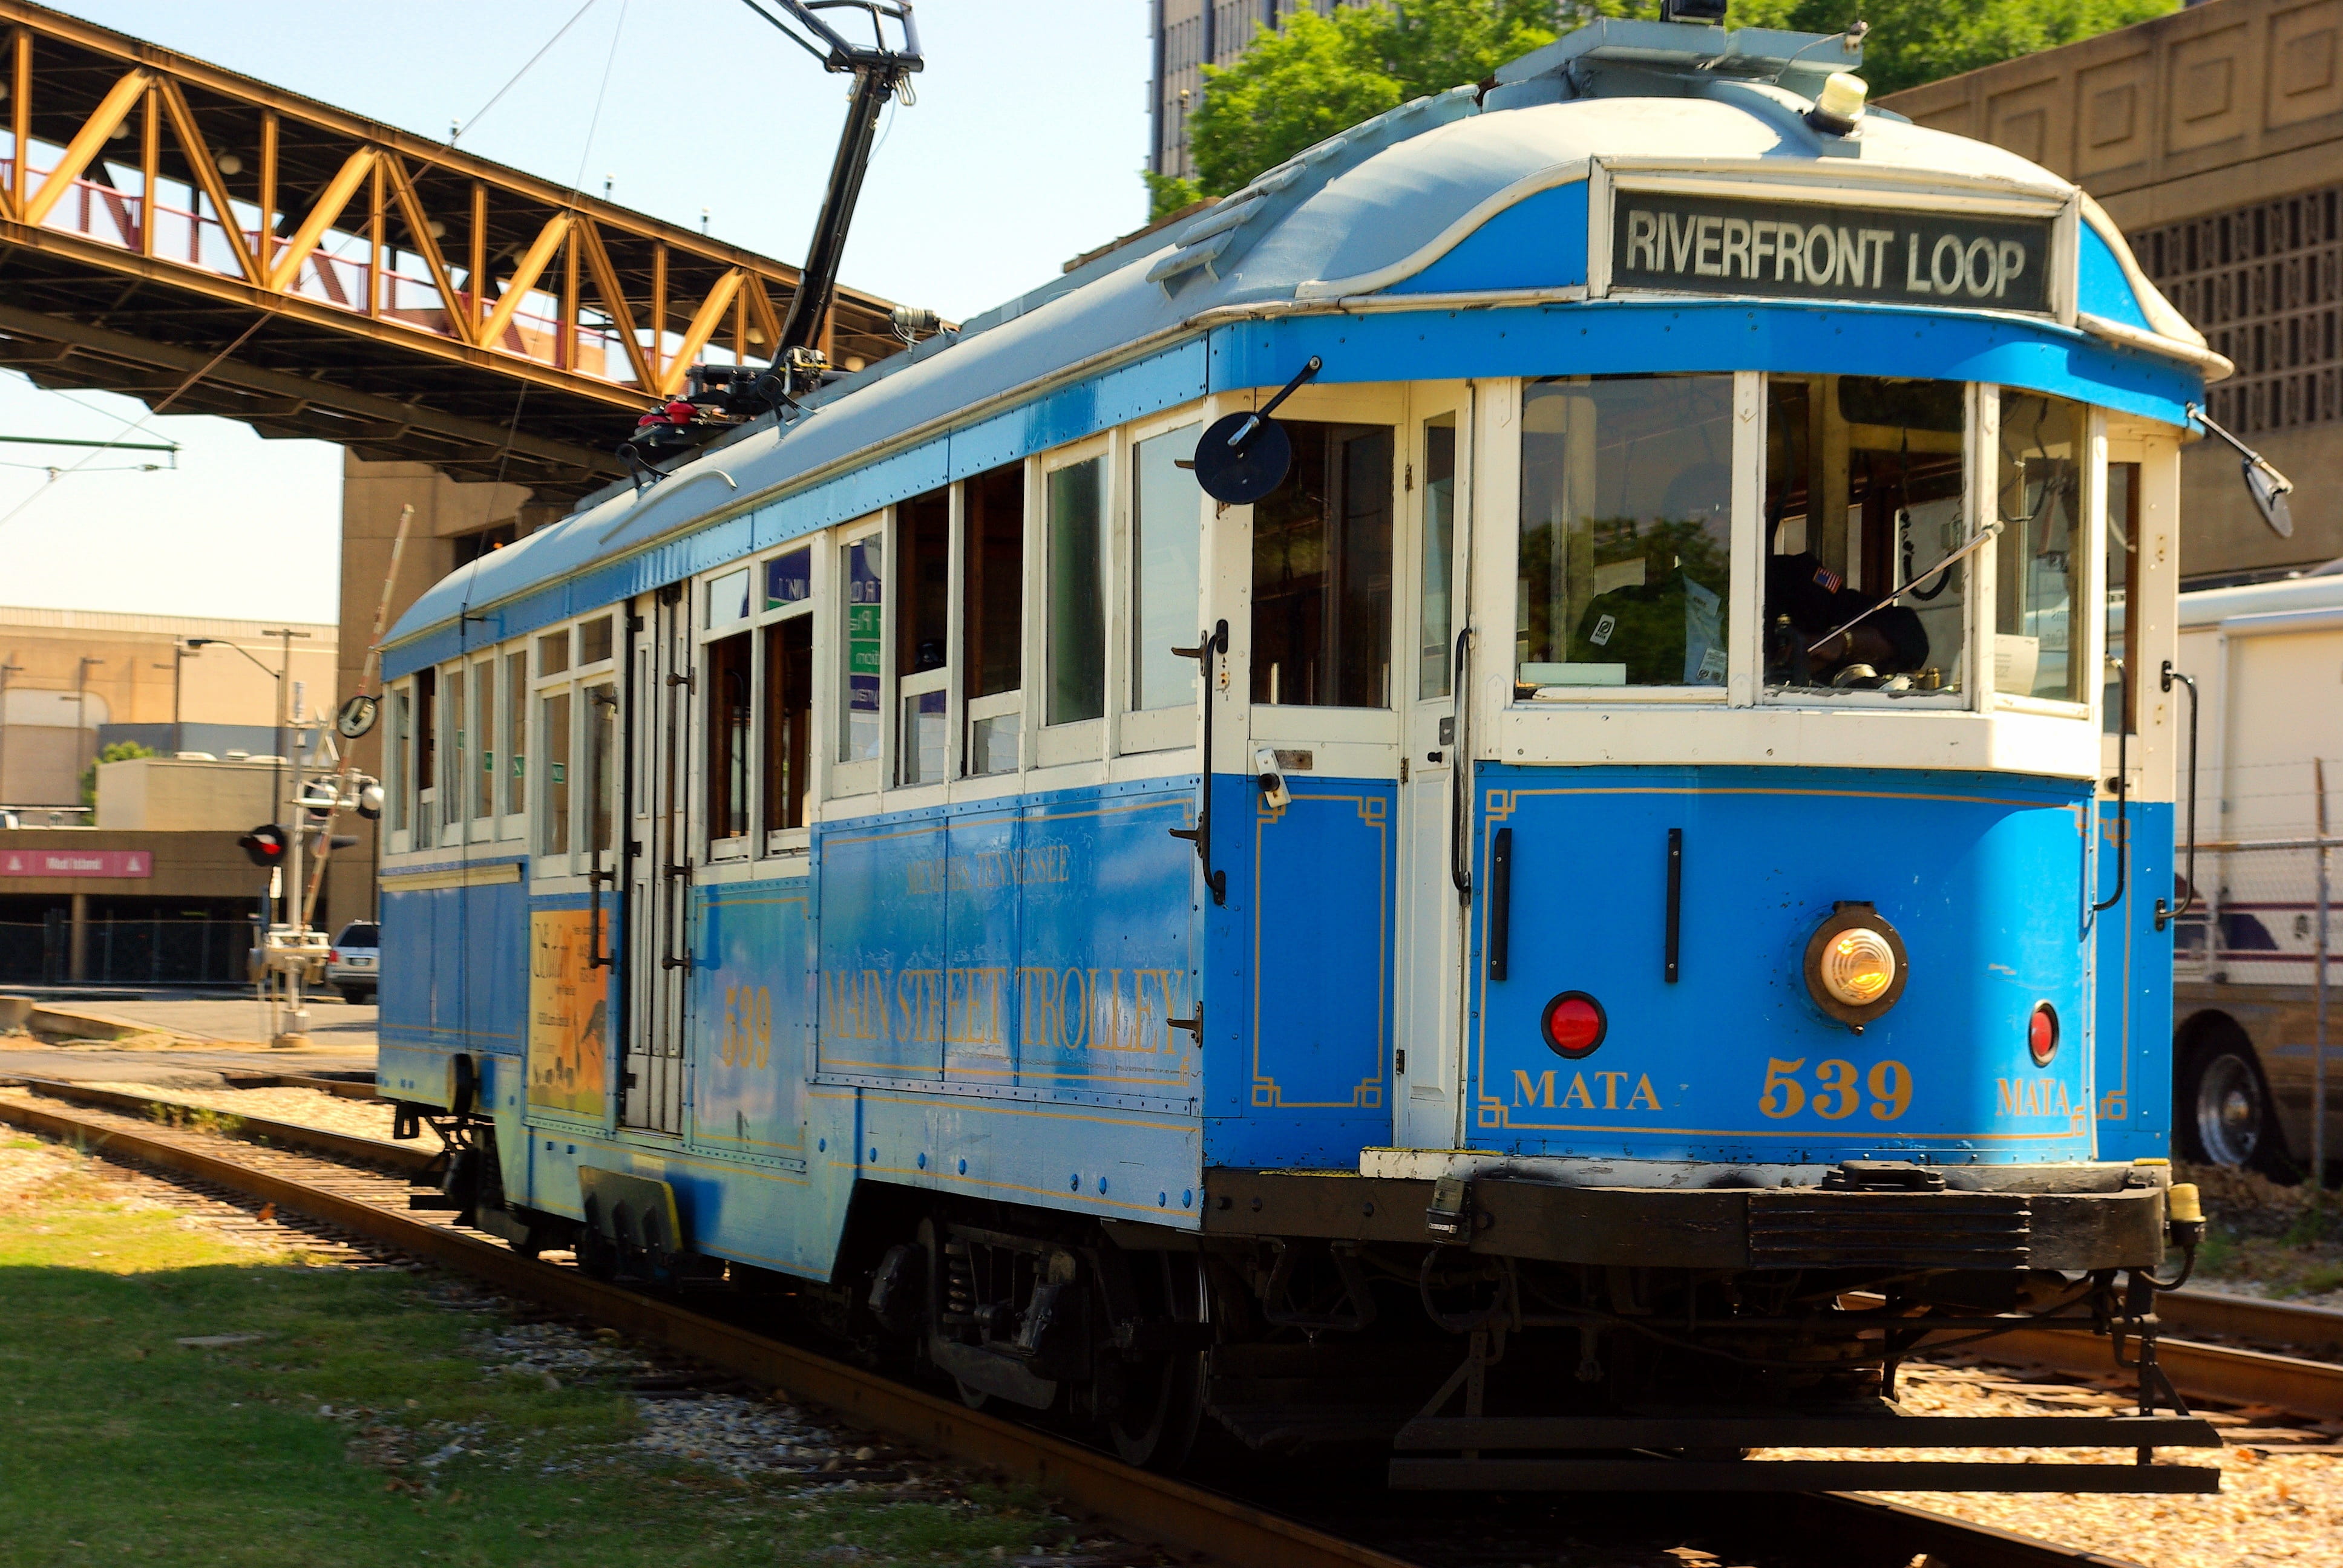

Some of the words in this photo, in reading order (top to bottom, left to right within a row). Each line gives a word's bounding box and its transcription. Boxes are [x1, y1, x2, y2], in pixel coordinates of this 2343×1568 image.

[1626, 209, 1894, 289] RIVERFRONT
[1907, 233, 2025, 298] LOOP
[977, 845, 1070, 887] TENNESSEE
[723, 984, 772, 1070] 539
[824, 969, 891, 1039] MAIN
[896, 967, 1007, 1044] STREET
[1017, 967, 1184, 1054] TROLLEY
[1512, 1070, 1662, 1110] MATA
[1758, 1057, 1913, 1121] 539
[1995, 1079, 2071, 1116] MATA
